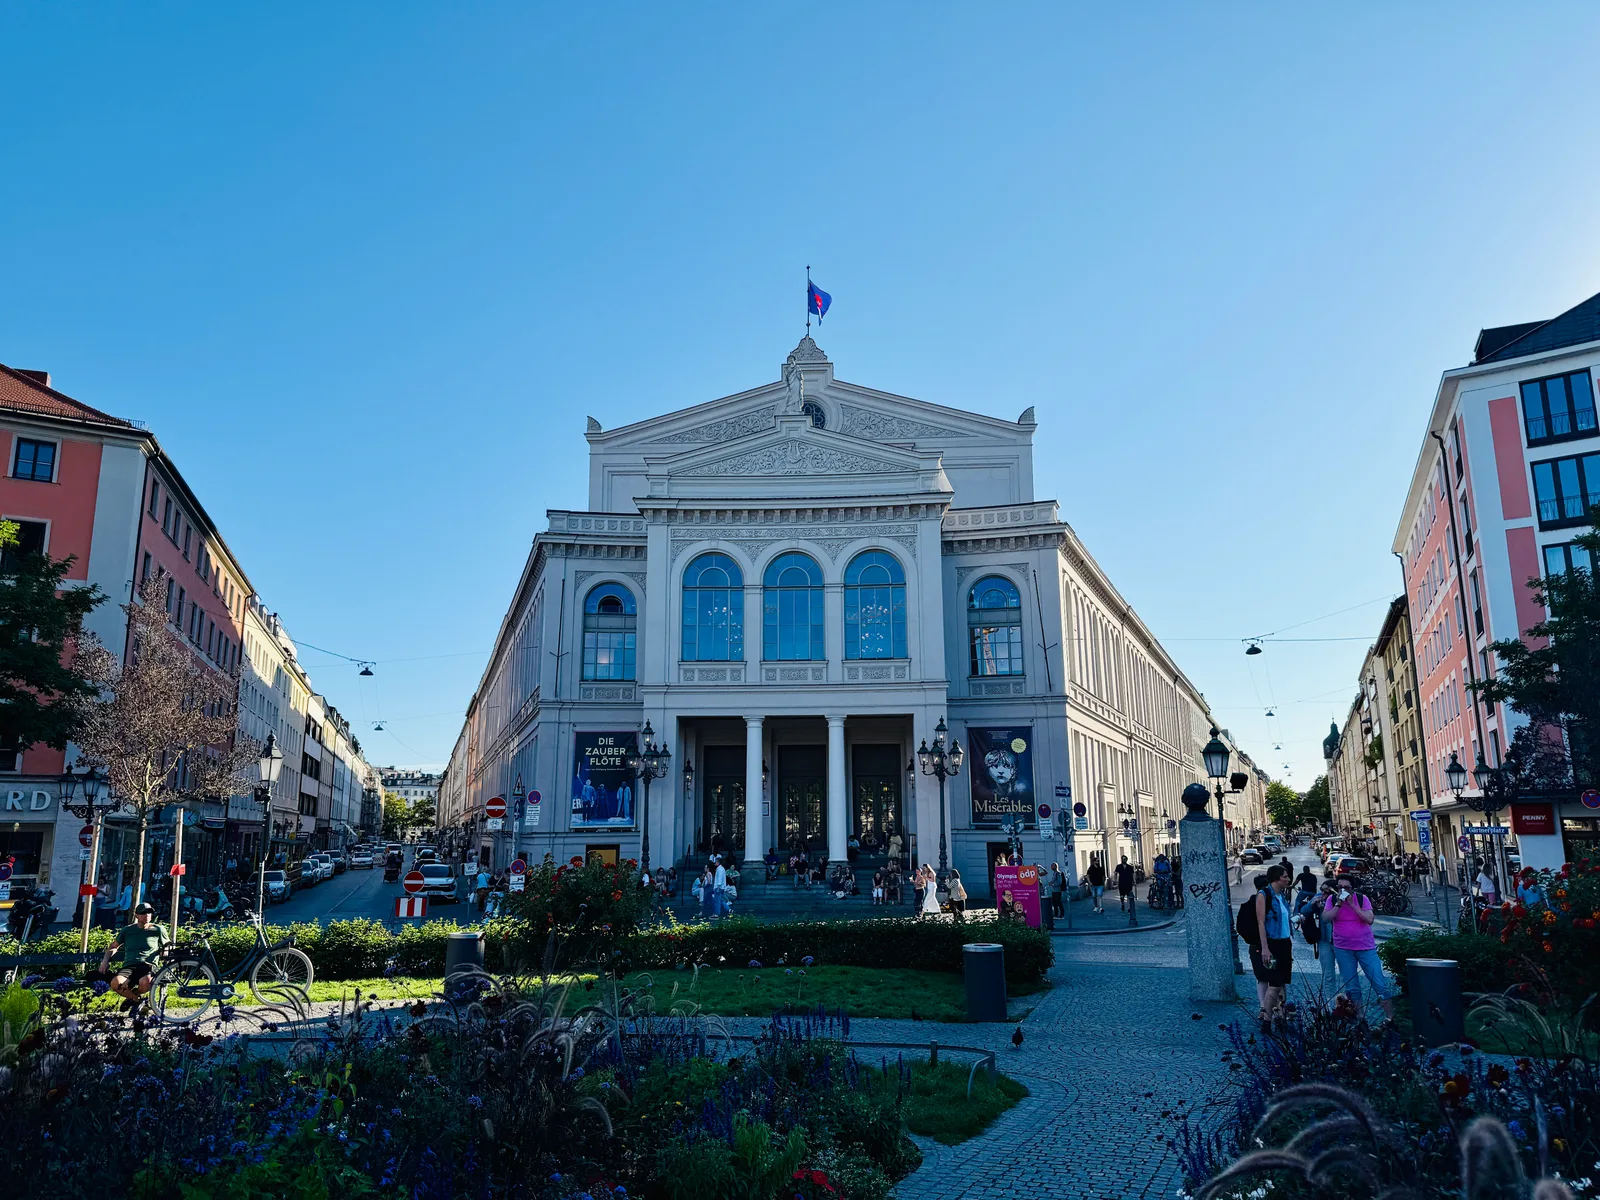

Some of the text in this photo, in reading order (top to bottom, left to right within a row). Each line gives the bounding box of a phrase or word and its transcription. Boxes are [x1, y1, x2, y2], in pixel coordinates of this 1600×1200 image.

[598, 737, 614, 745] DIE
[590, 756, 621, 765] FLÖTE
[994, 793, 1009, 804] Les
[1468, 826, 1505, 835] Gärtnerplatz
[1020, 869, 1036, 879] ödp
